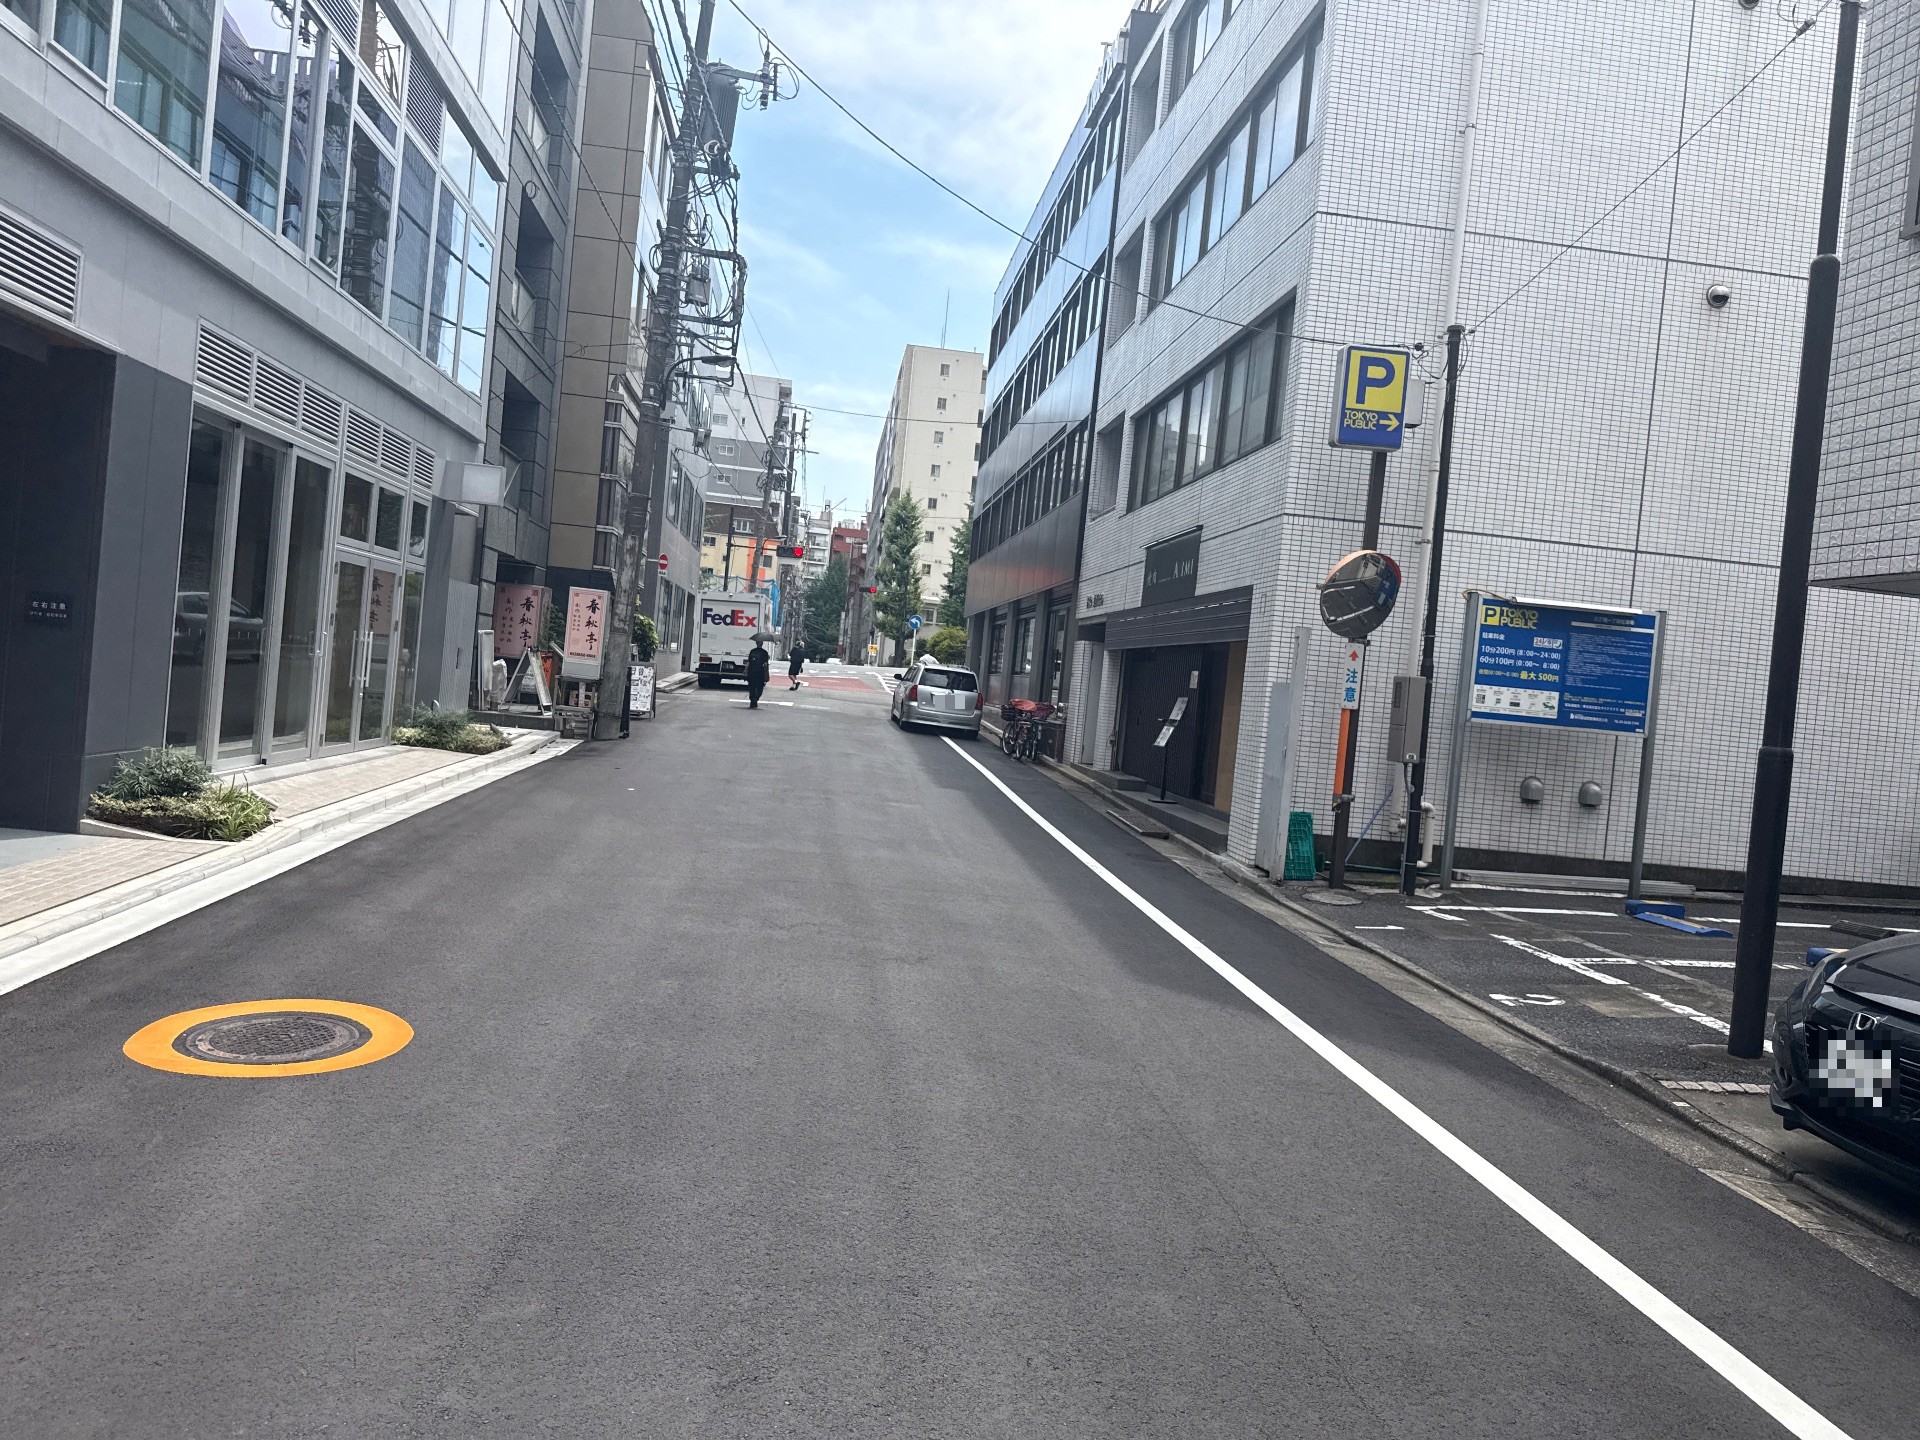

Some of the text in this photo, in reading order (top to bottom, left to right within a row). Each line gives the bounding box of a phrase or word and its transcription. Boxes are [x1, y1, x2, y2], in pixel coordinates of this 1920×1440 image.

[1356, 356, 1395, 405] P
[1345, 410, 1378, 421] TOKYO
[1344, 419, 1377, 430] PUBLIC
[702, 608, 757, 627] FedEx
[1484, 607, 1497, 623] P
[1501, 606, 1539, 620] TOKYO
[519, 596, 535, 648] 春秋亭
[585, 598, 601, 650] 春秋亭
[1500, 616, 1538, 629] PUBLIC
[1481, 645, 1516, 656] 10分200円
[1480, 655, 1515, 667] 60分100円
[1344, 667, 1359, 702] 注意
